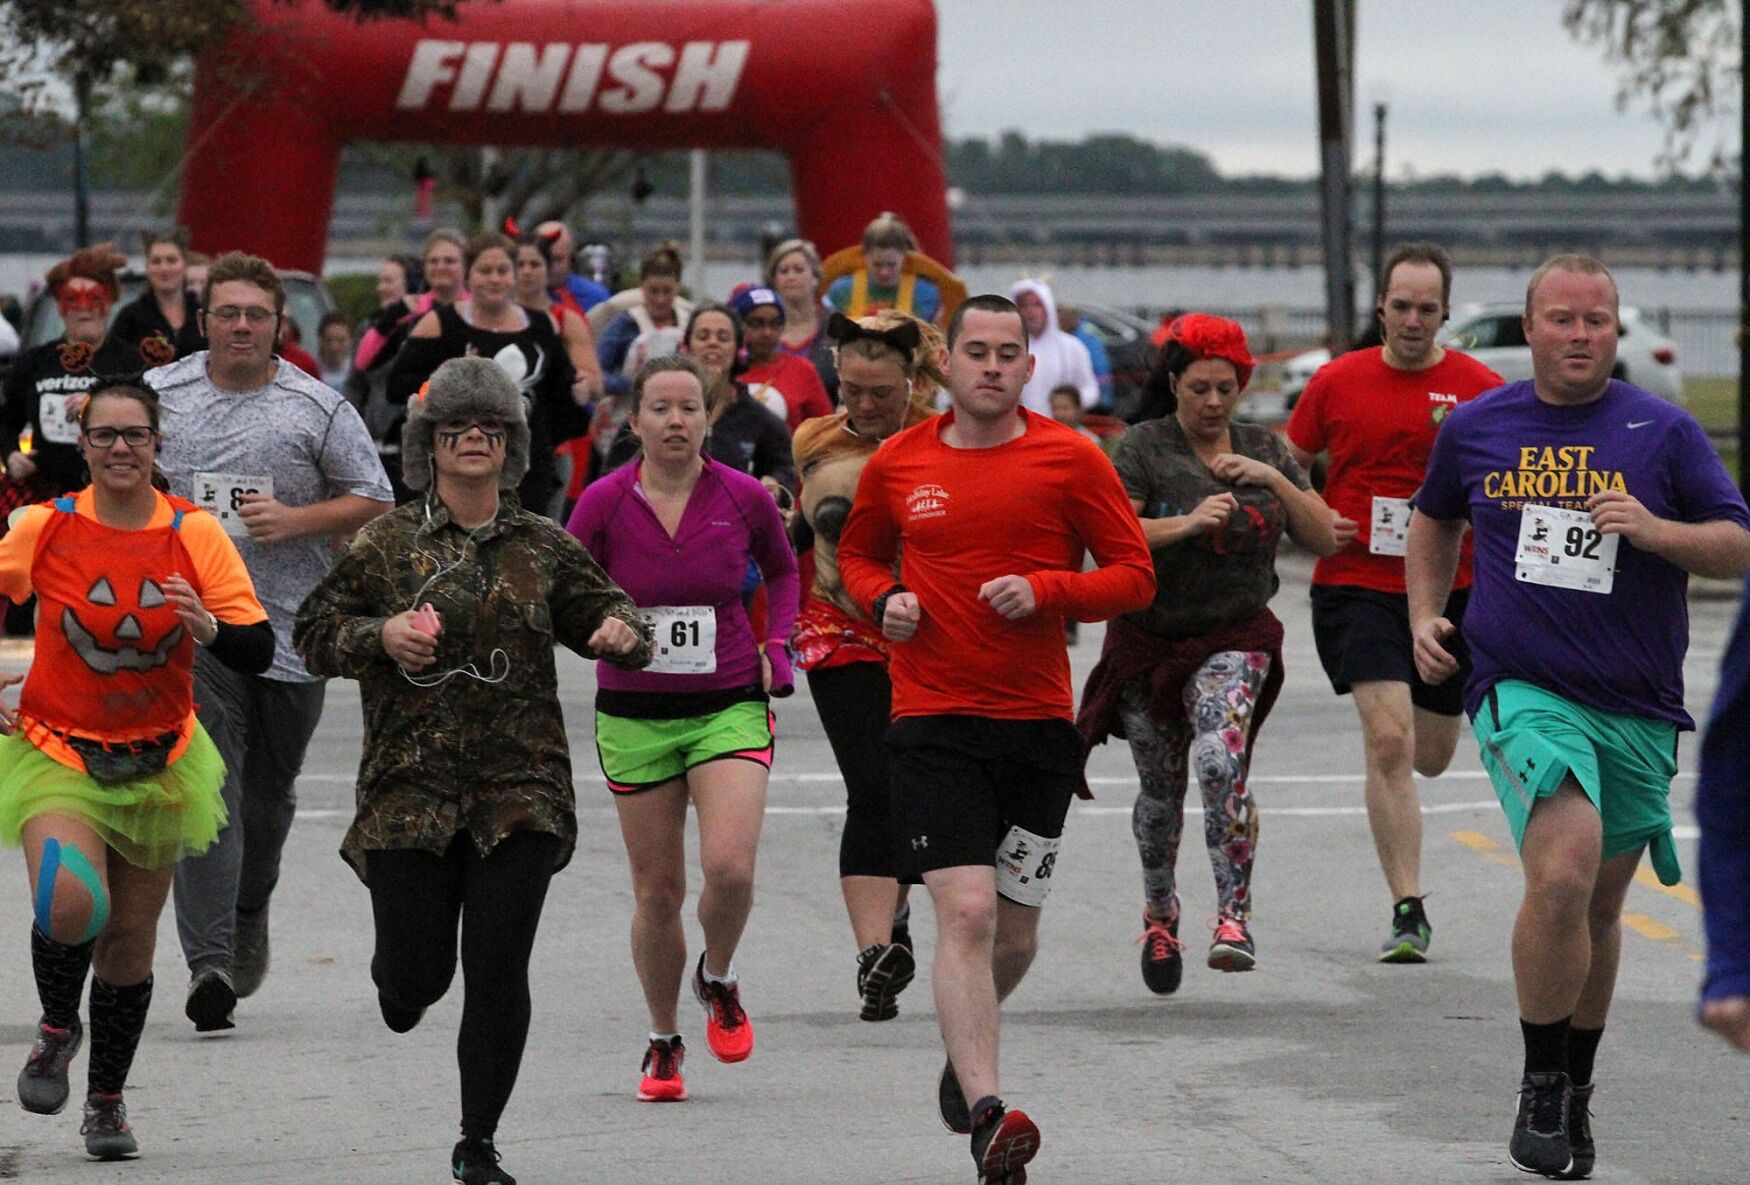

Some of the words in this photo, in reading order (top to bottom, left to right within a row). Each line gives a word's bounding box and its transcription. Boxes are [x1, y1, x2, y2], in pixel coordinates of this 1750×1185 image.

[399, 40, 750, 113] FINISH
[1519, 446, 1595, 471] EAST
[1484, 471, 1628, 498] CAROLINA
[1565, 526, 1602, 560] 92
[671, 620, 699, 647] 61
